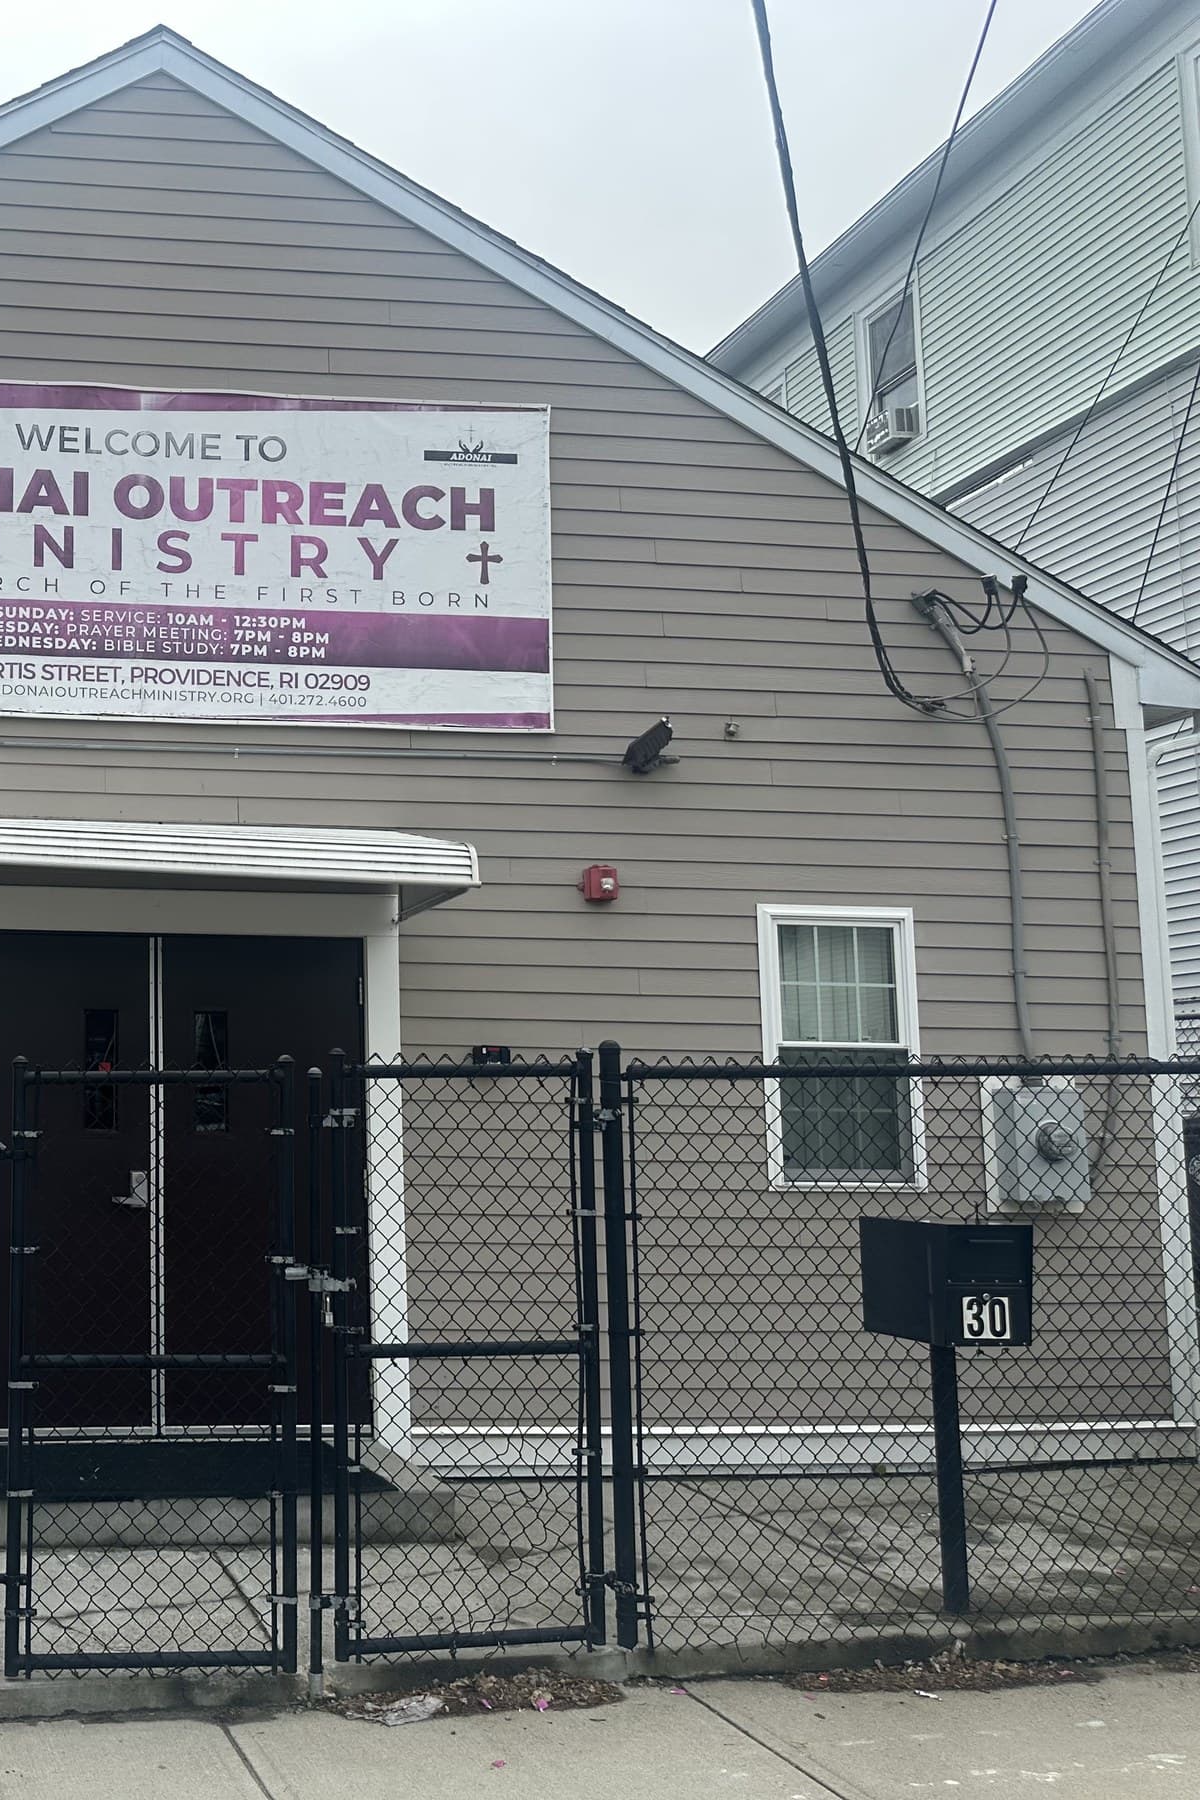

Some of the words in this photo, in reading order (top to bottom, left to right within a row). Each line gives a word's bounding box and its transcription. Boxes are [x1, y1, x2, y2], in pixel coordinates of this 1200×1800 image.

[16, 423, 221, 460] WELCOME
[236, 433, 287, 462] TO
[450, 453, 492, 462] ADONAI
[114, 473, 495, 532] OUTREACH
[90, 580, 131, 595] OF
[161, 582, 226, 600] THE
[257, 586, 363, 605] FIRST
[393, 591, 488, 608] BORN
[81, 609, 161, 624] SERVICE:
[167, 612, 214, 626] 10AM
[233, 615, 306, 629] 12:30PM
[67, 623, 136, 638] PRAYER
[143, 626, 227, 641] MEETING:
[234, 629, 271, 643] 7PM
[291, 631, 329, 644] 8PM
[104, 639, 156, 653] BIBLE
[162, 641, 224, 655] STUDY:
[230, 643, 267, 657] 7PM
[287, 646, 326, 659] 8PM
[41, 663, 125, 685] STREET,
[130, 666, 274, 690] PROVIDENCE,
[279, 672, 299, 689] RI
[304, 673, 371, 691] 02909
[268, 693, 367, 708] 401.272.4600
[966, 1298, 1007, 1338] 30
